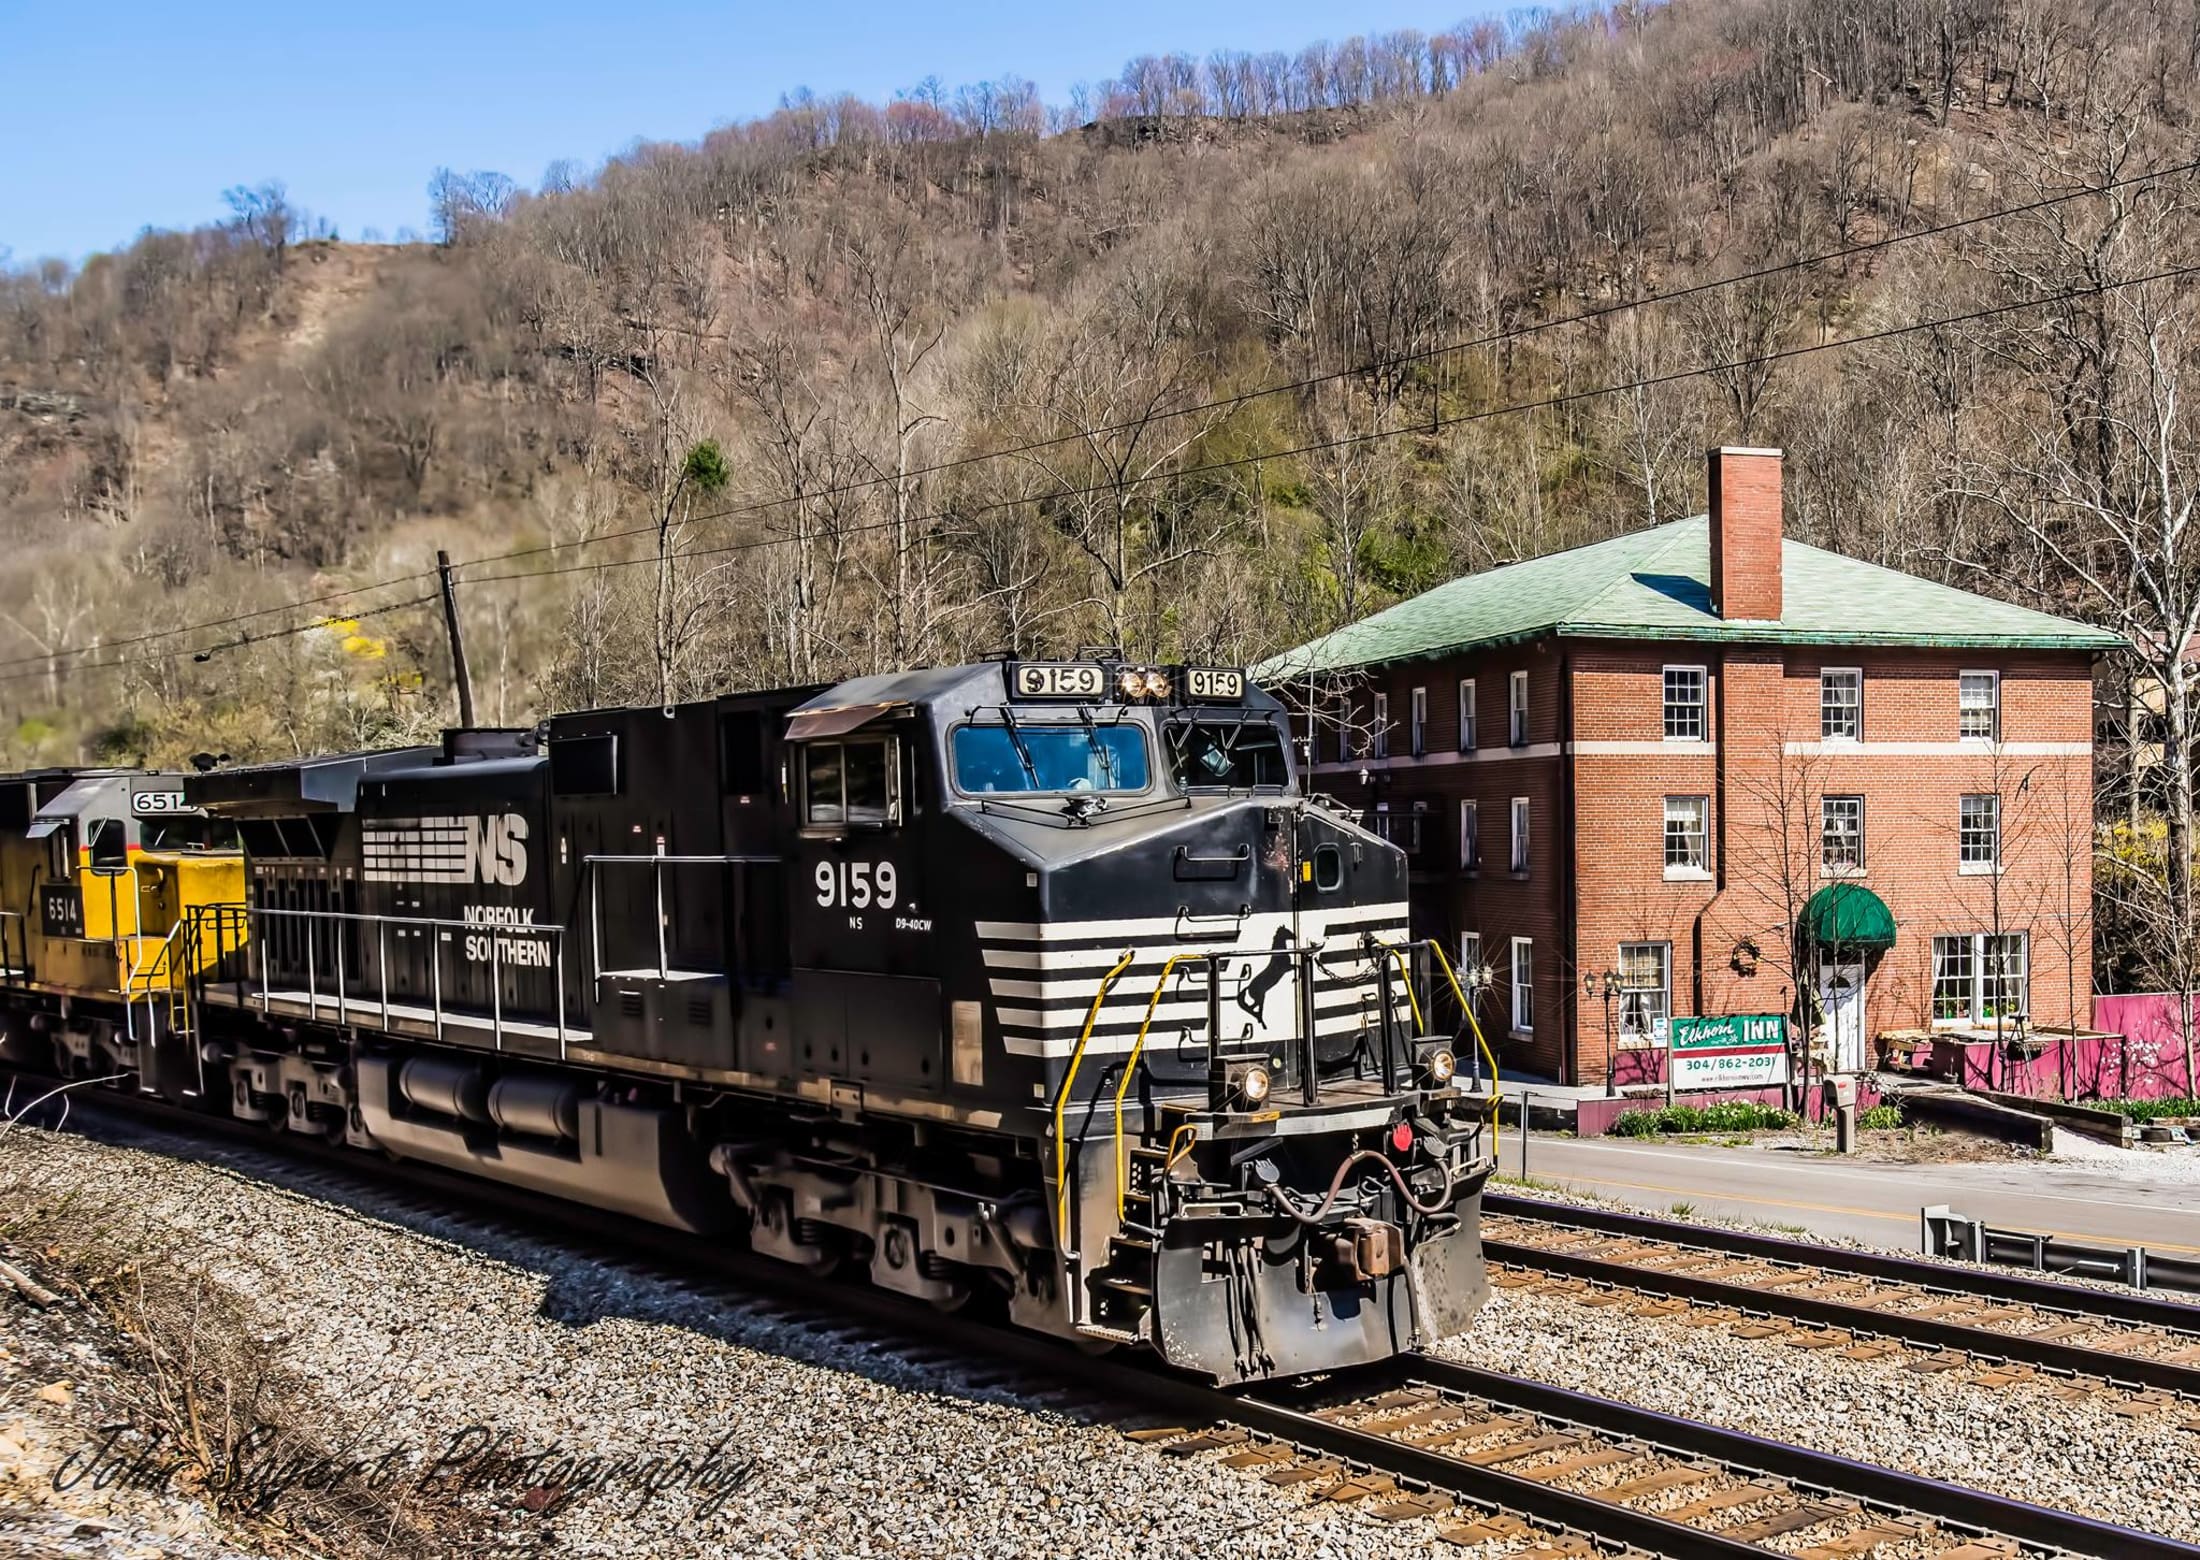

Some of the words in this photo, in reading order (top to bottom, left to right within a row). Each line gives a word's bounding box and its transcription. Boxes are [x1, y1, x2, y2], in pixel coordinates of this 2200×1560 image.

[1026, 668, 1095, 693] 9159
[1194, 672, 1237, 695] 9159
[463, 813, 529, 886] NS
[815, 860, 897, 909] 9159
[48, 897, 77, 921] 6514
[463, 904, 537, 934] NORFOLK
[849, 916, 863, 930] NS
[895, 917, 933, 932] D9-40CW
[1679, 1024, 1735, 1046] Elkhorn
[1743, 1019, 1779, 1041] INN
[1686, 1056, 1776, 1071] 304/862-2031
